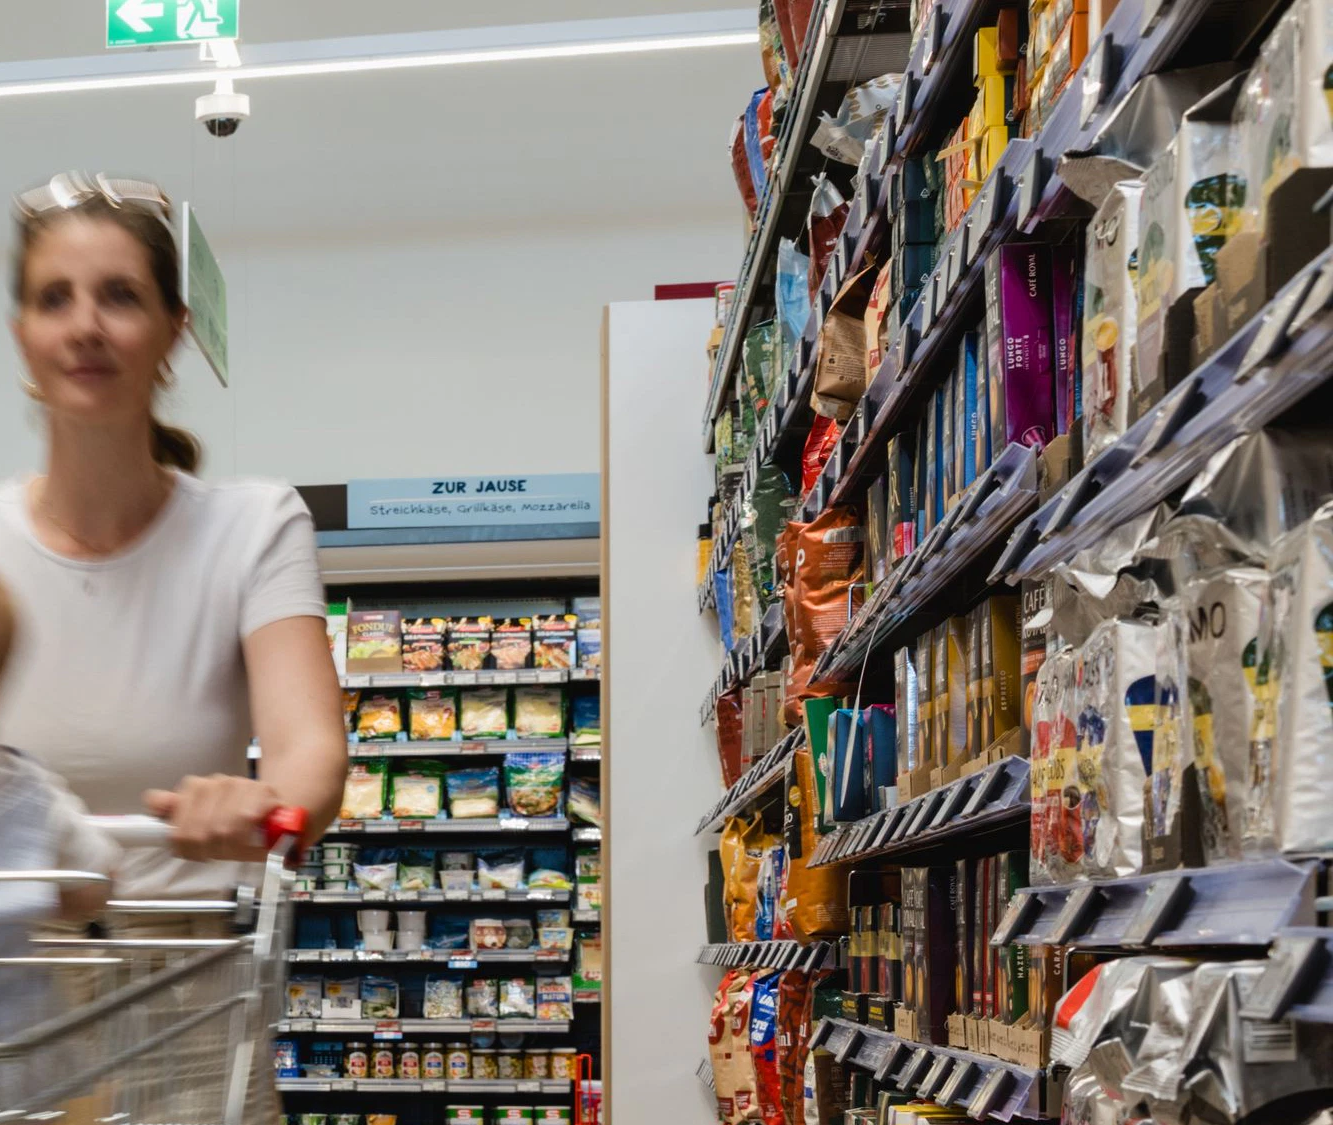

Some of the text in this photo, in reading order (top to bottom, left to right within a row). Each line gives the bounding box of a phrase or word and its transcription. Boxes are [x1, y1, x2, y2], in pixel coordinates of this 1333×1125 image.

[1007, 337, 1015, 369] LUNGO
[432, 480, 528, 494] ZUR JAUSE
[370, 500, 591, 517] Streichkäse, Grillkäse, Mozzarella
